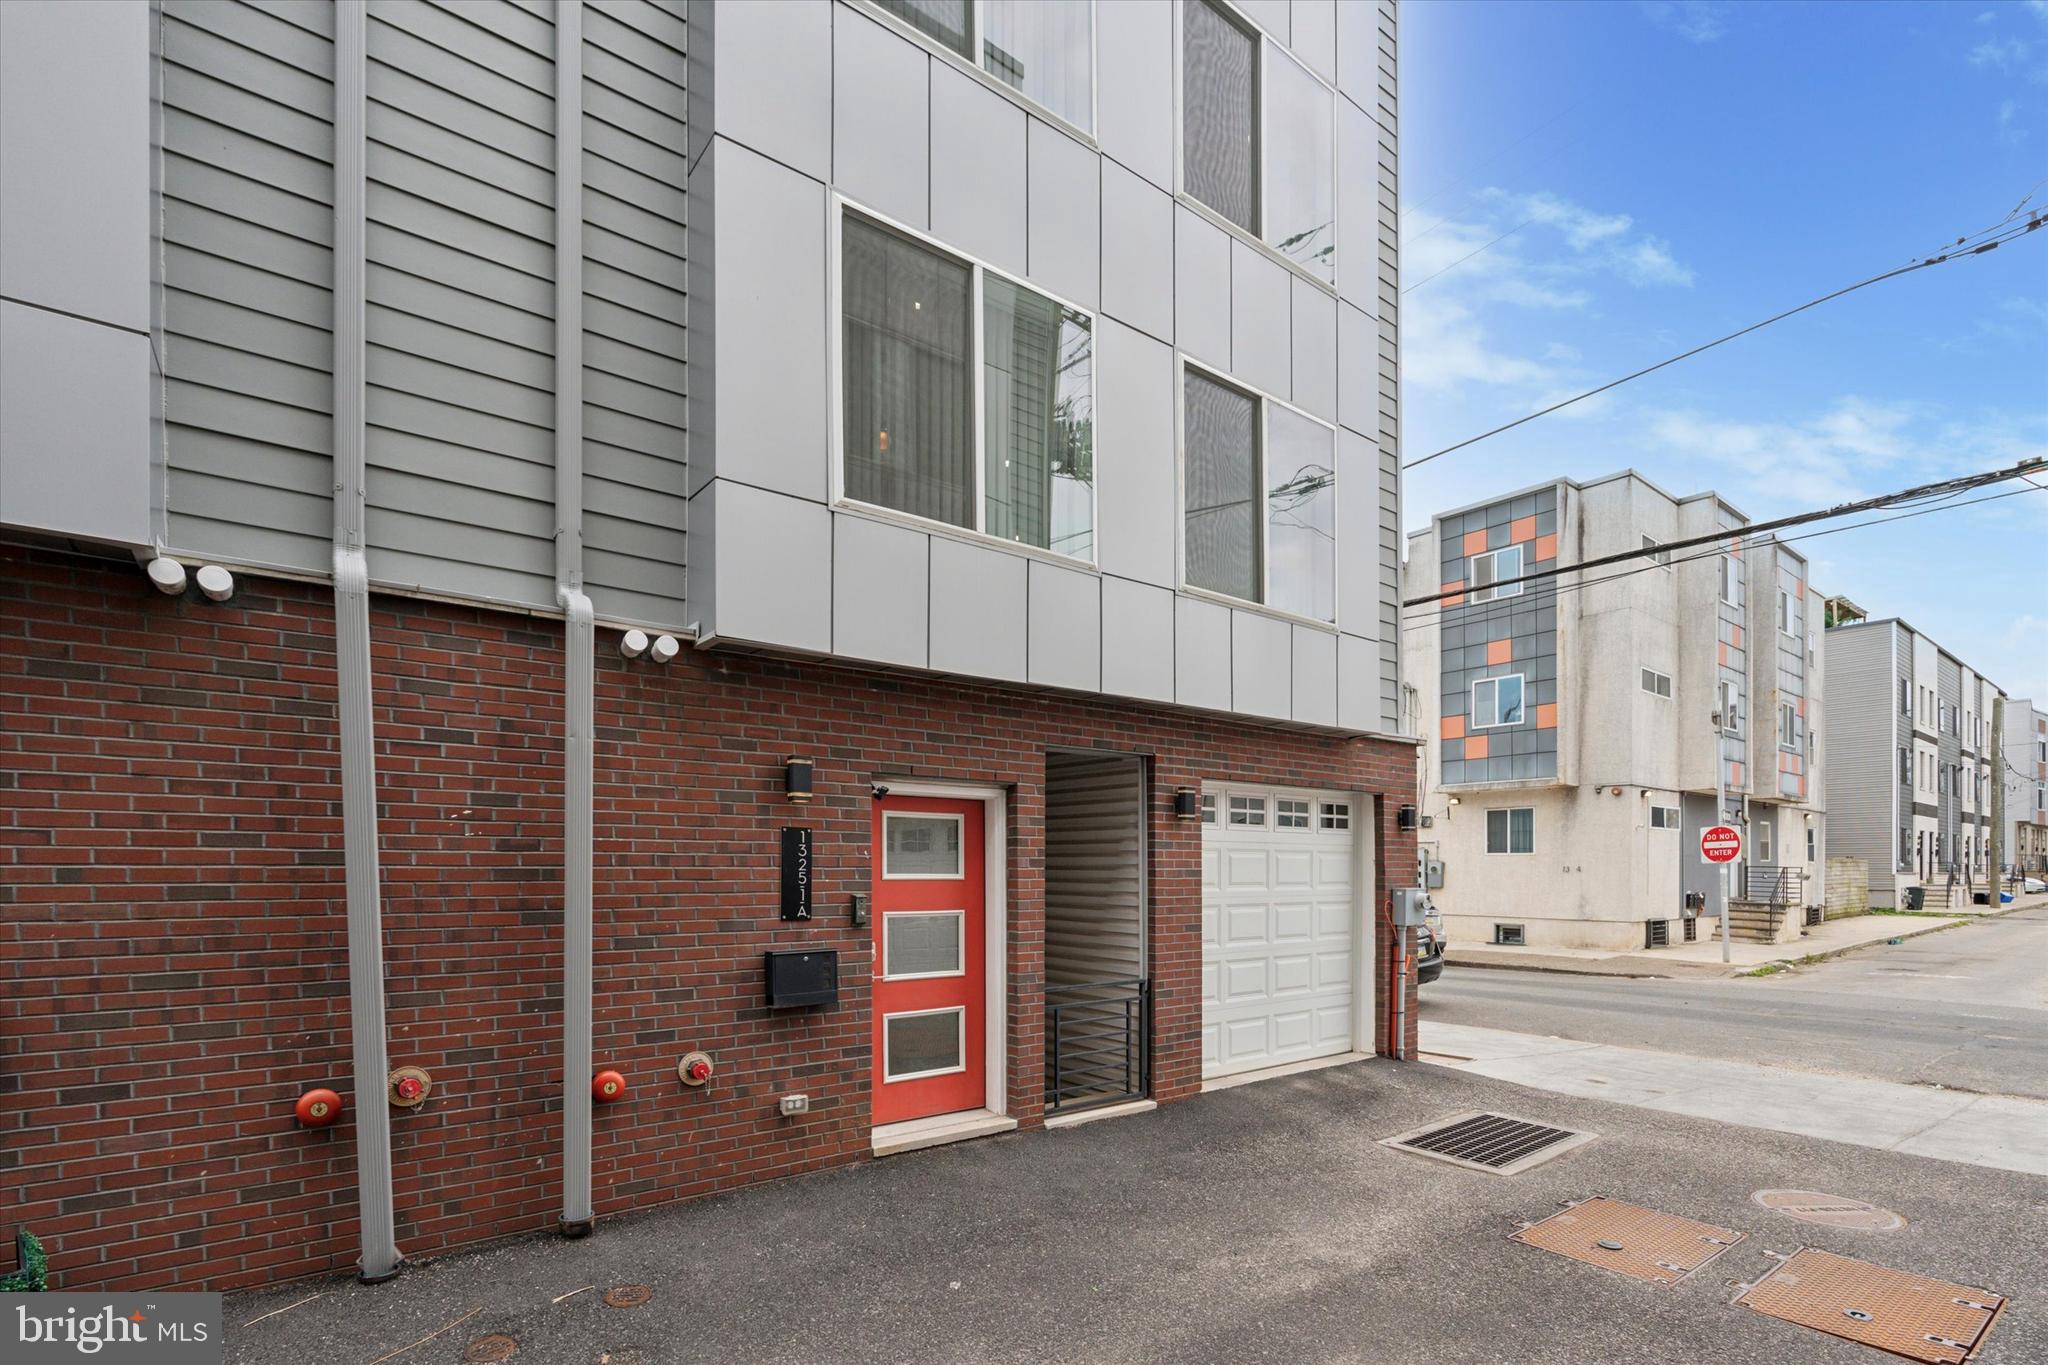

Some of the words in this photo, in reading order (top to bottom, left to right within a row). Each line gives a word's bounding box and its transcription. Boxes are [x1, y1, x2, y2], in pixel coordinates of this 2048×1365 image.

[1706, 833, 1717, 841] DO
[1719, 832, 1735, 840] NOT
[1709, 848, 1733, 857] ENTER
